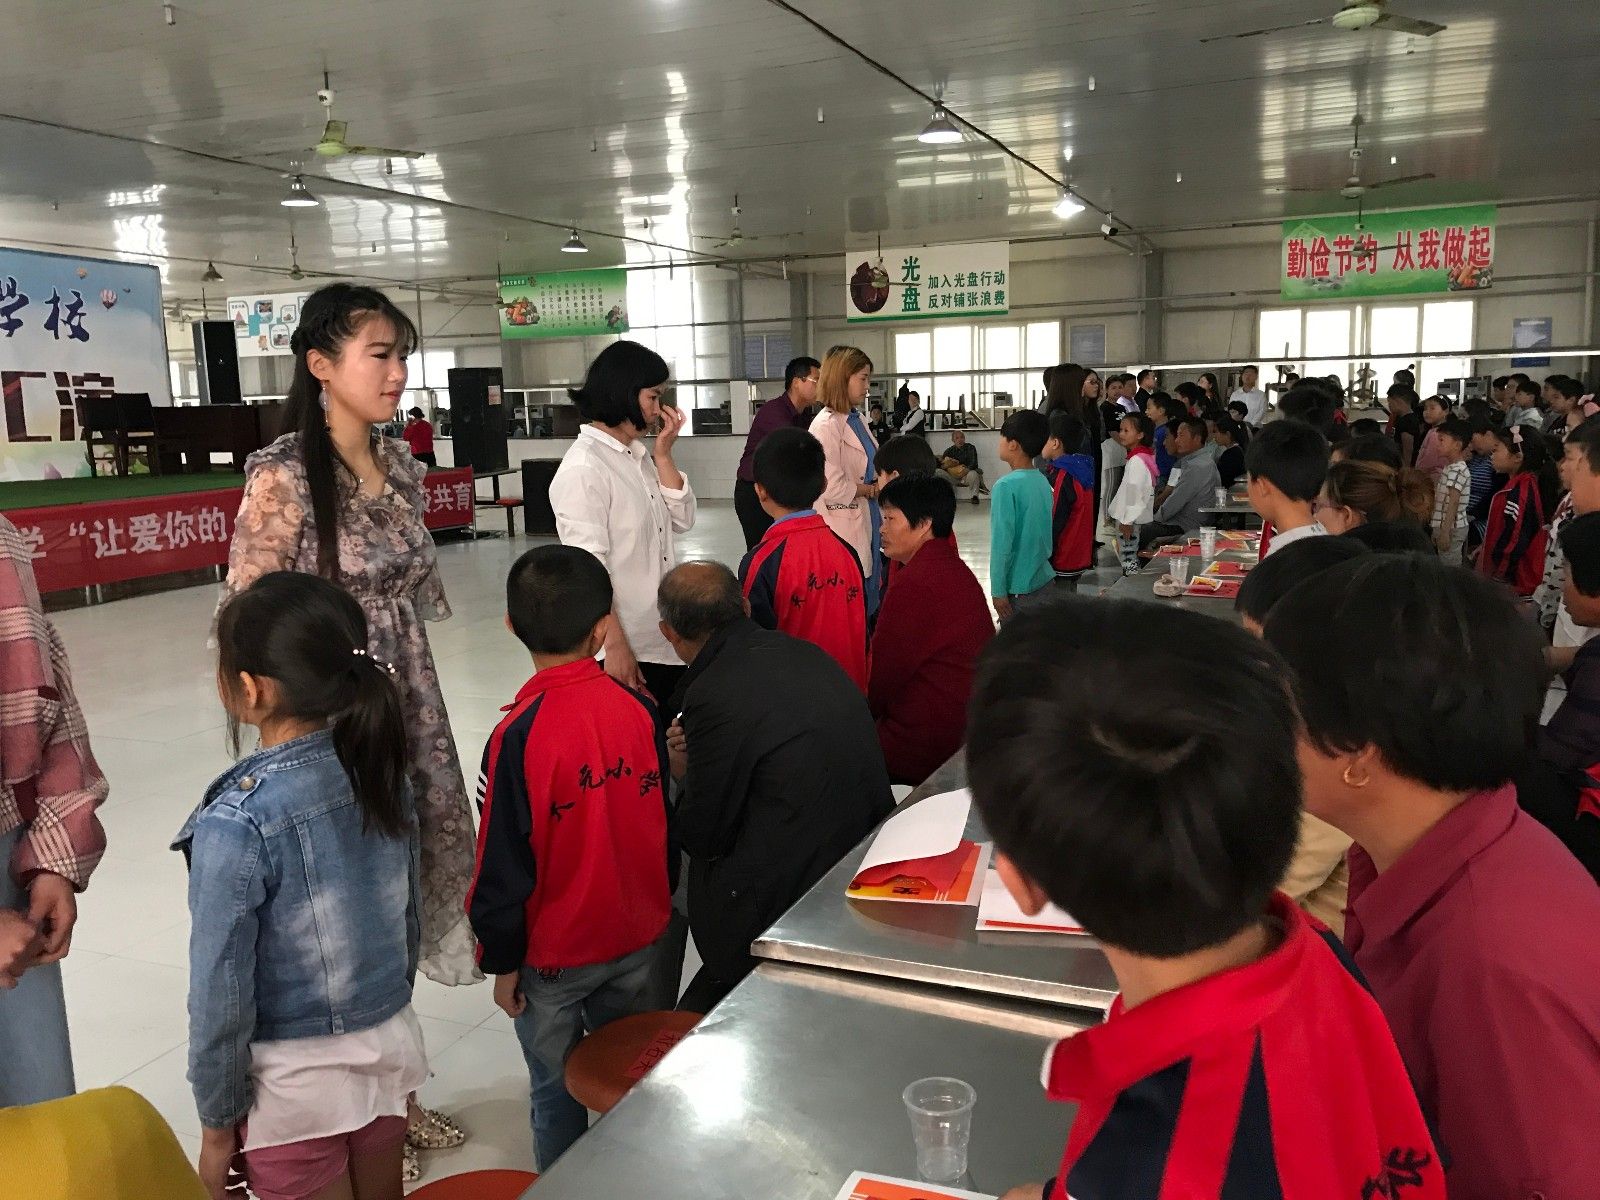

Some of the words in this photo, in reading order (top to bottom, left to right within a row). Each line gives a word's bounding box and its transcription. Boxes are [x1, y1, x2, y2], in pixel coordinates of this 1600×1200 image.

[1287, 233, 1377, 279] 勤俭节约
[1392, 225, 1490, 272] 从我做起
[901, 256, 921, 312] 光盘
[928, 270, 1005, 289] 加入光盘行动
[928, 290, 1005, 309] 反对铺张浪费
